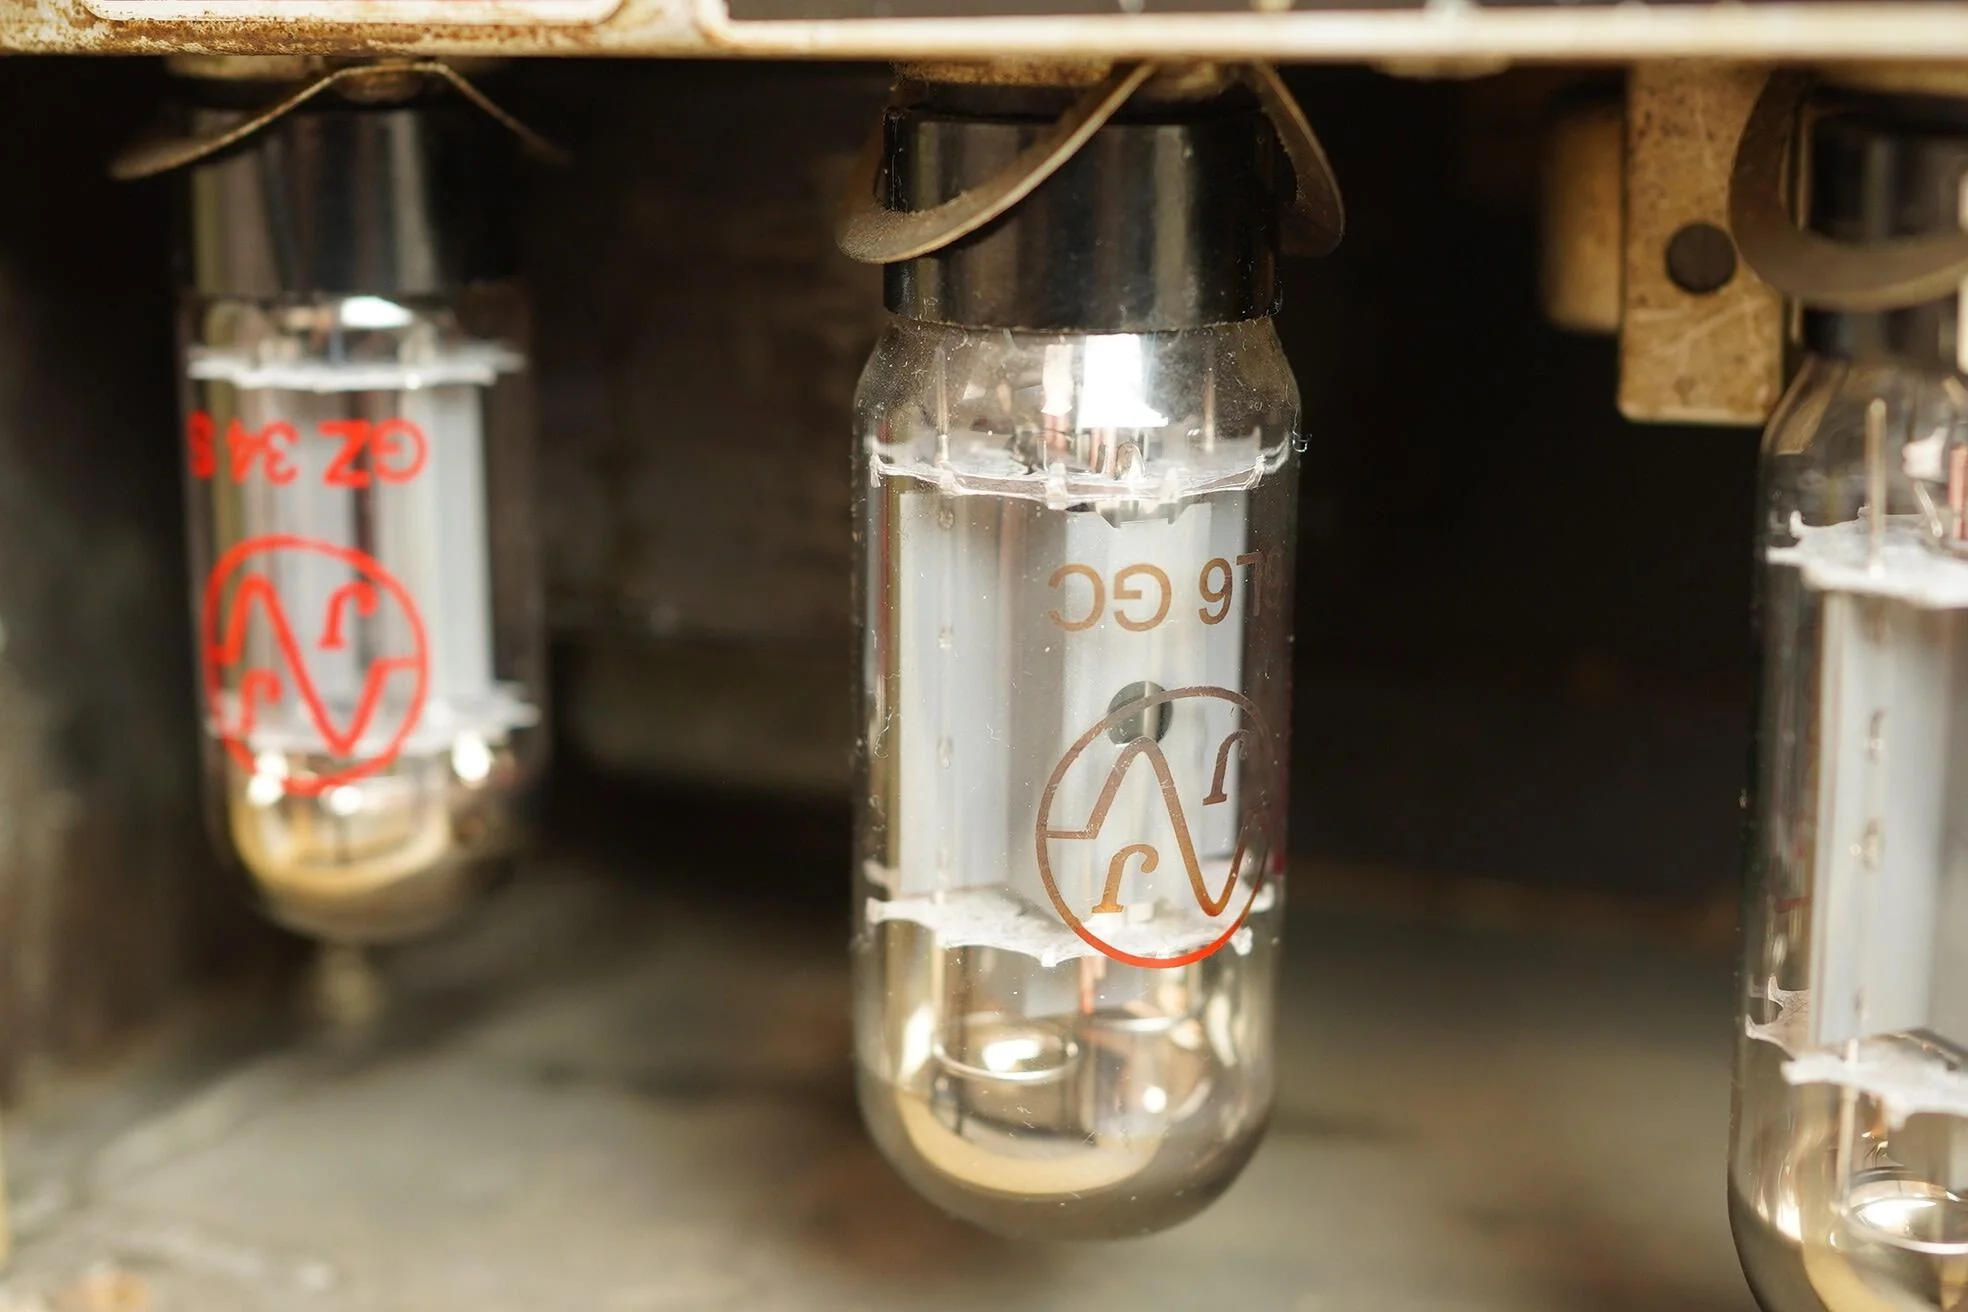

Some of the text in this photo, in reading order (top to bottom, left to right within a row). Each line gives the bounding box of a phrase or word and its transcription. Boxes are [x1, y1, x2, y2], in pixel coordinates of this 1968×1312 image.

[226, 417, 298, 487] 34
[317, 418, 429, 488] GZ
[1048, 563, 1172, 633] GC
